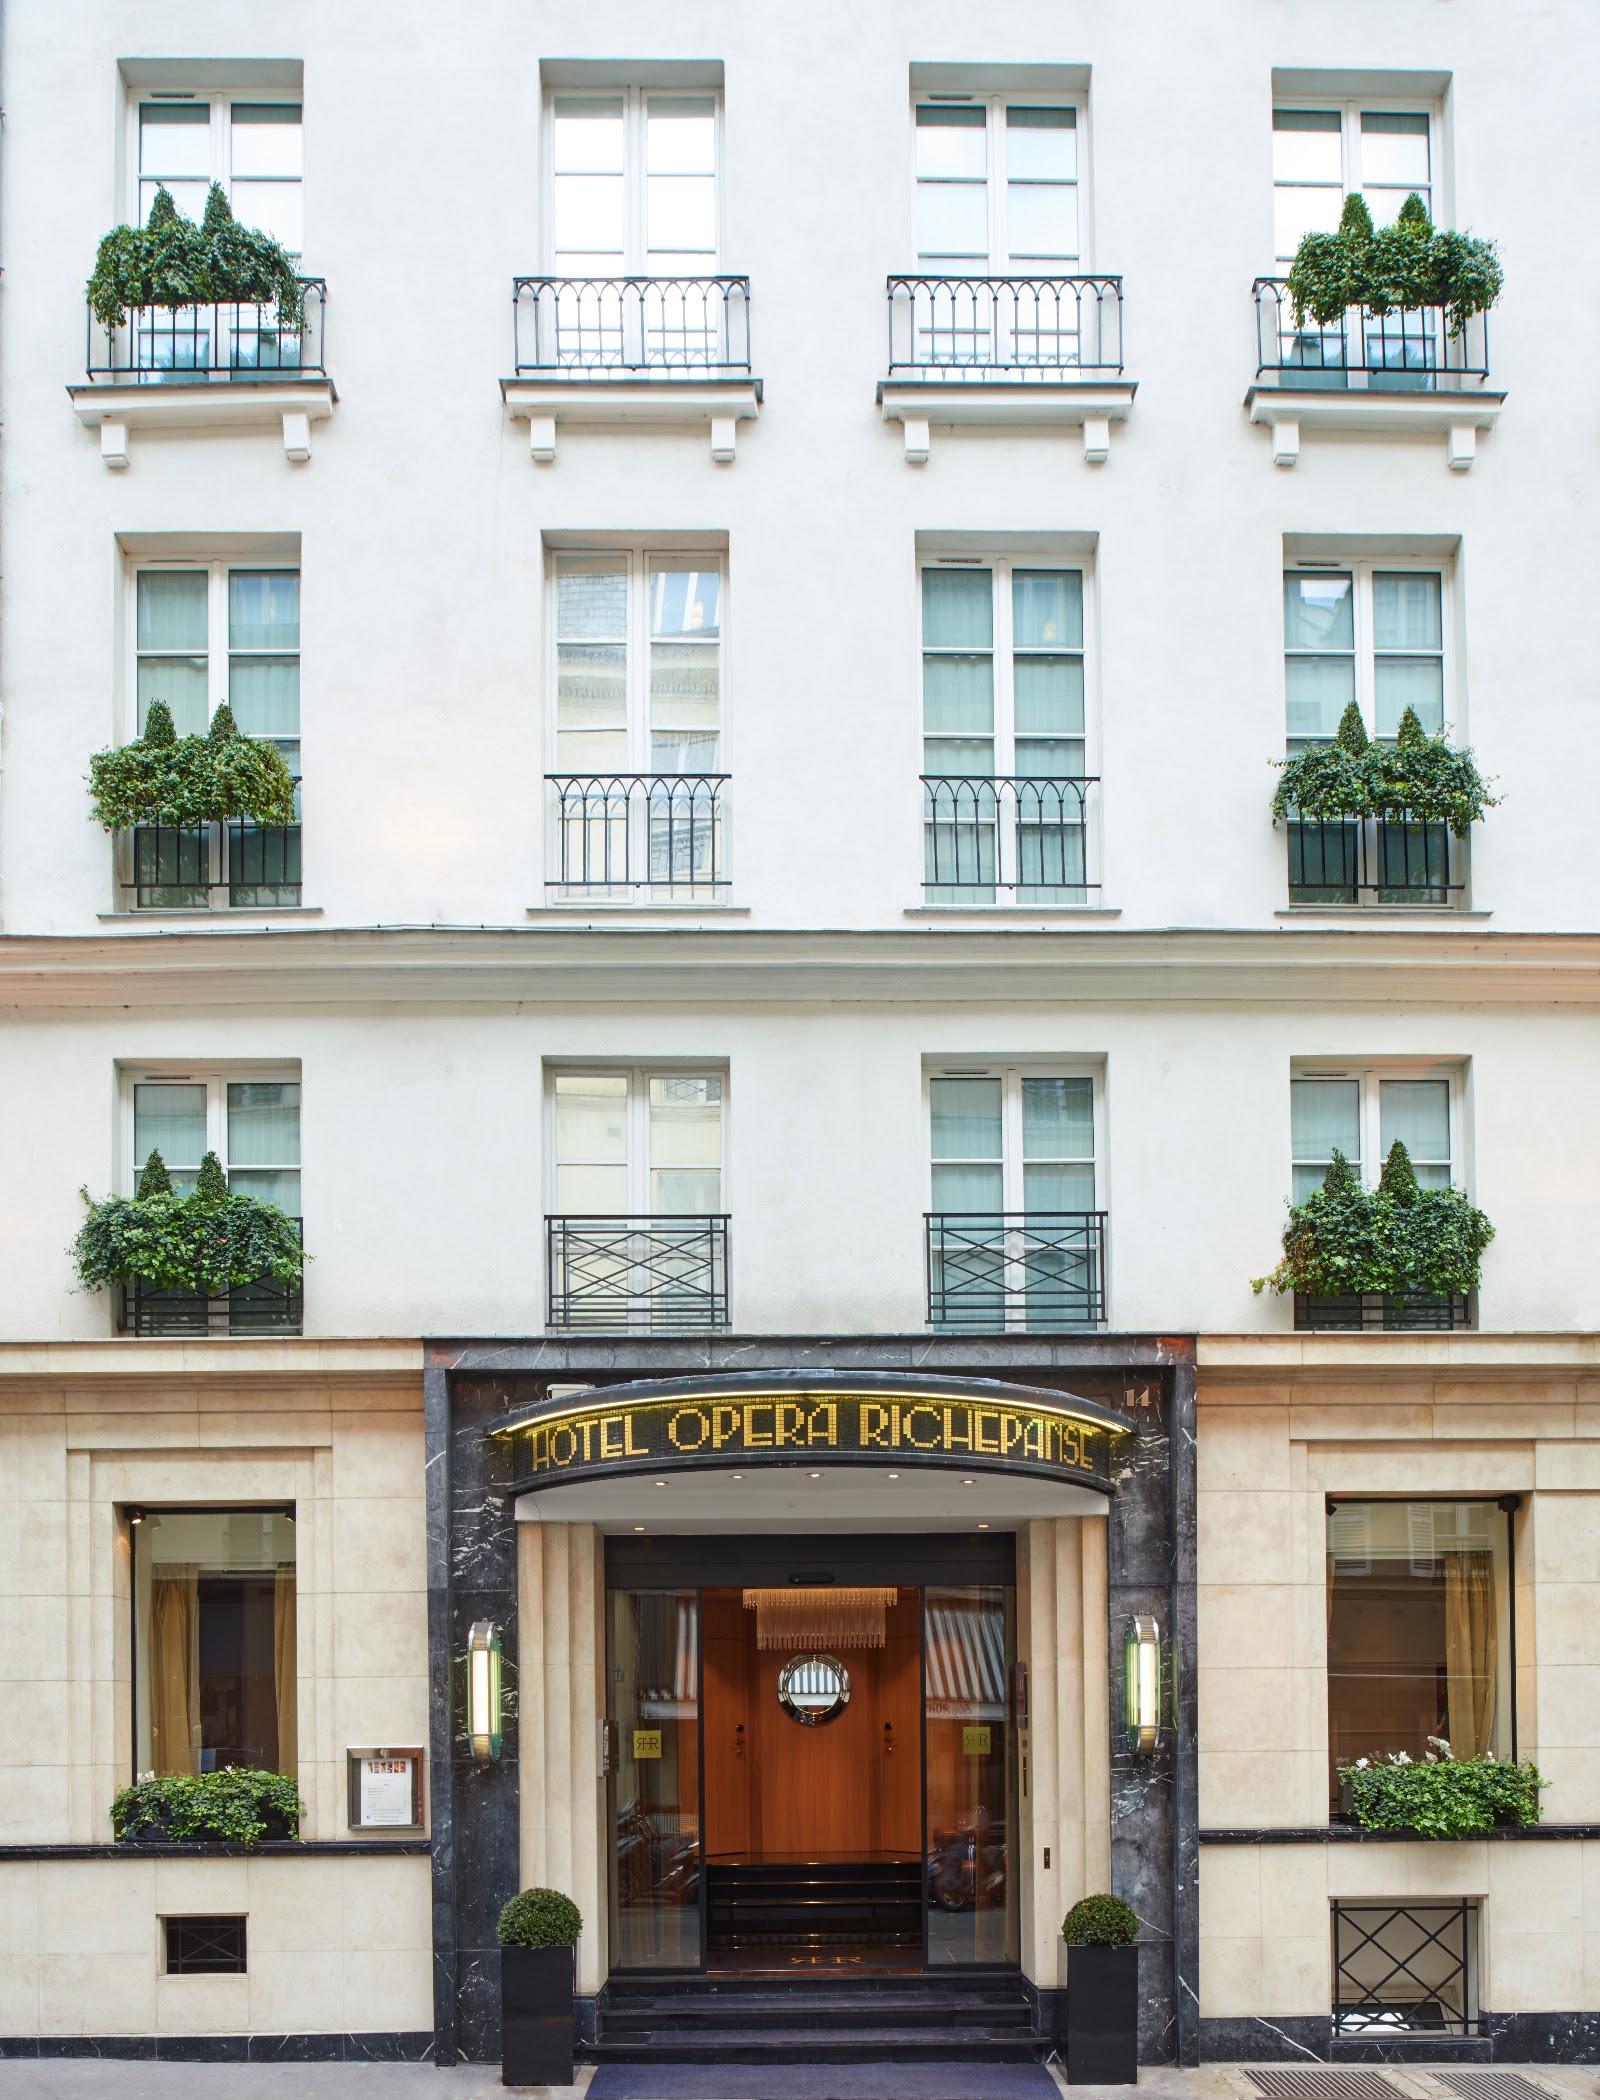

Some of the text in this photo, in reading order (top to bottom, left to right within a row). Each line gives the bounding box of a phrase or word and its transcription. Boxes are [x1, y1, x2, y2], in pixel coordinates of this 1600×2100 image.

[1124, 1388, 1152, 1407] 14
[532, 1403, 1093, 1472] HOTEL OPERA RICHEPANSE
